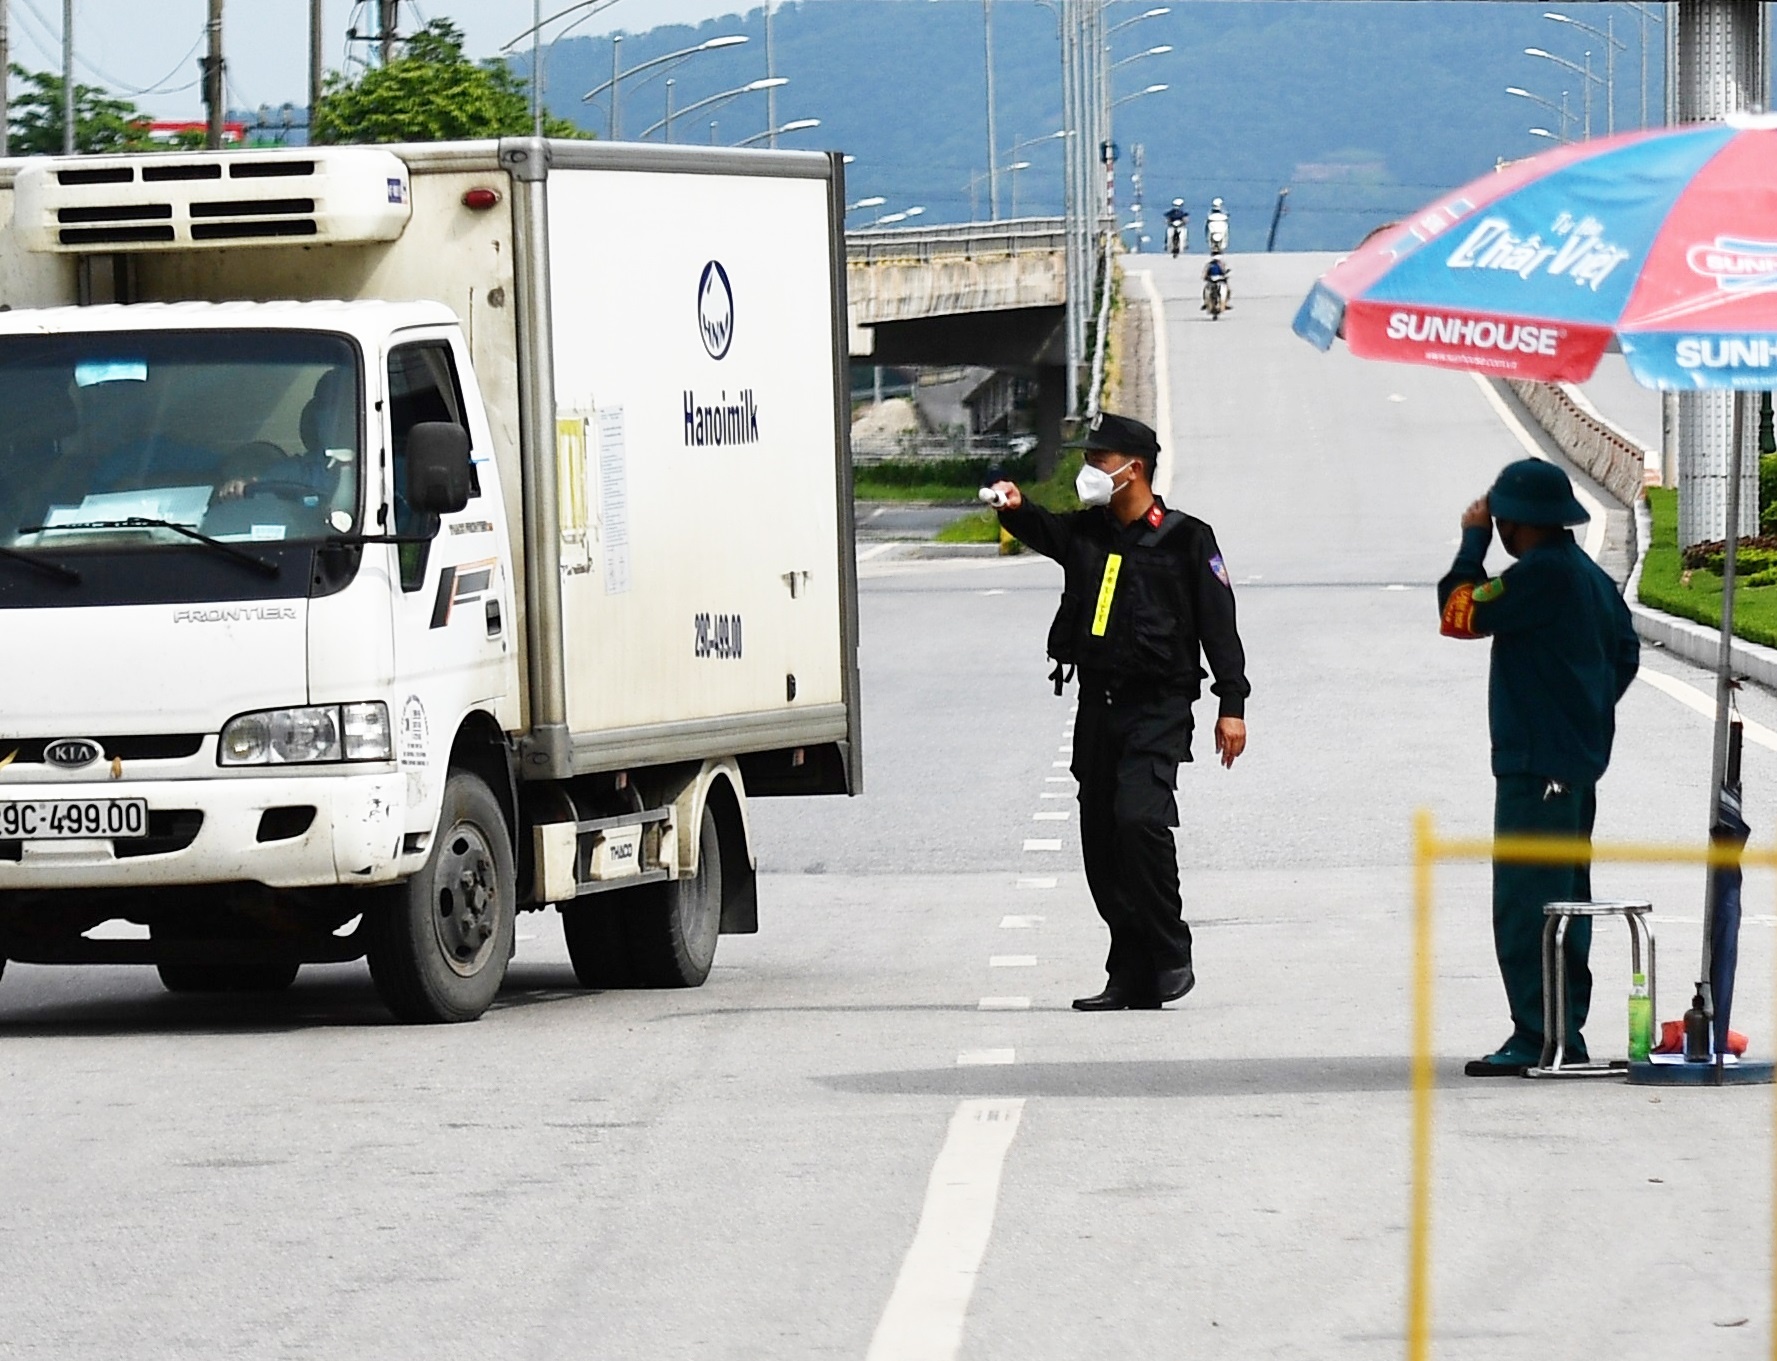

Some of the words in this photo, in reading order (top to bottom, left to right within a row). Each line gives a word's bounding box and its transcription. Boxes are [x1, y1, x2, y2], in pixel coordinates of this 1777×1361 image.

[1387, 312, 1558, 356] SUNHOUSE
[683, 388, 760, 447] Hanoimilk
[173, 607, 298, 624] FRONTIER
[55, 746, 91, 761] KIA
[0, 802, 142, 835] 9C-499.00
